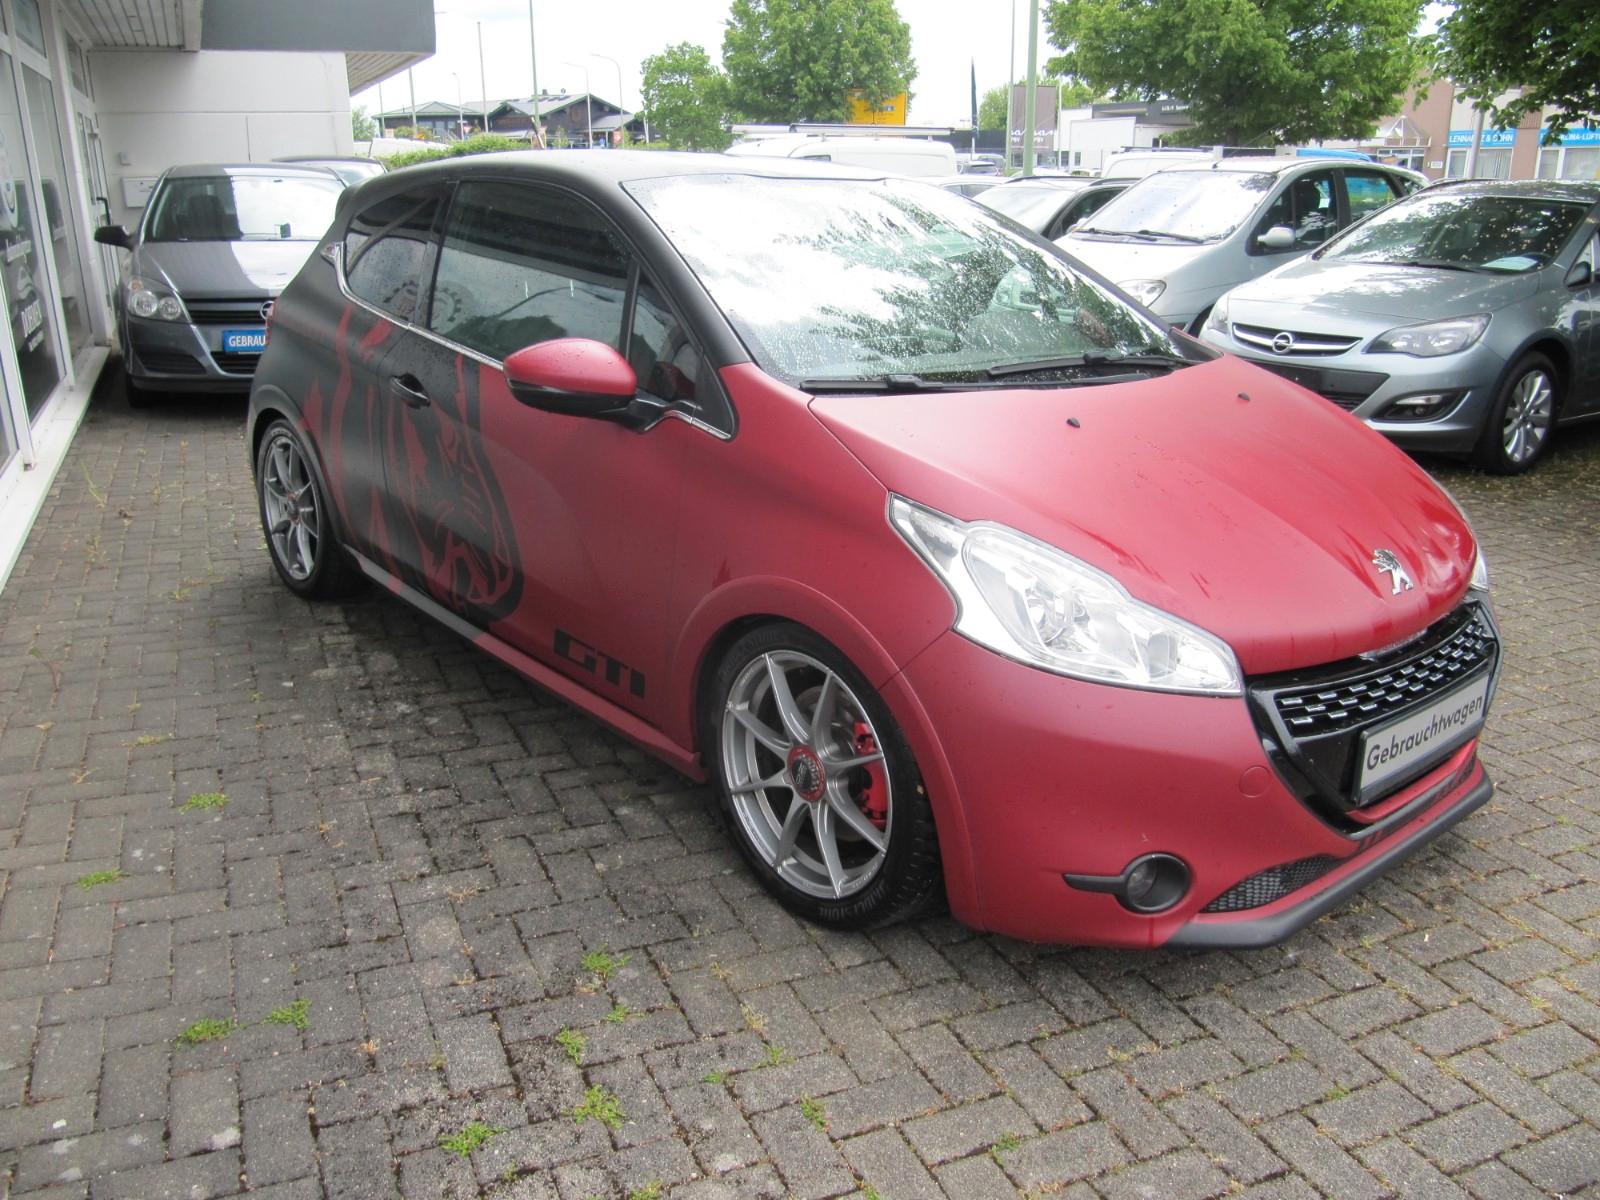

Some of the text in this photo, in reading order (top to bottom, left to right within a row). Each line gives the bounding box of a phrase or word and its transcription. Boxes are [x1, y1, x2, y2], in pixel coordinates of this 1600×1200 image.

[1449, 134, 1485, 143] LENNAZ
[1492, 134, 1513, 142] SOHN
[228, 335, 266, 347] GEBRAU
[1366, 695, 1483, 771] Gebrauchtwagen
